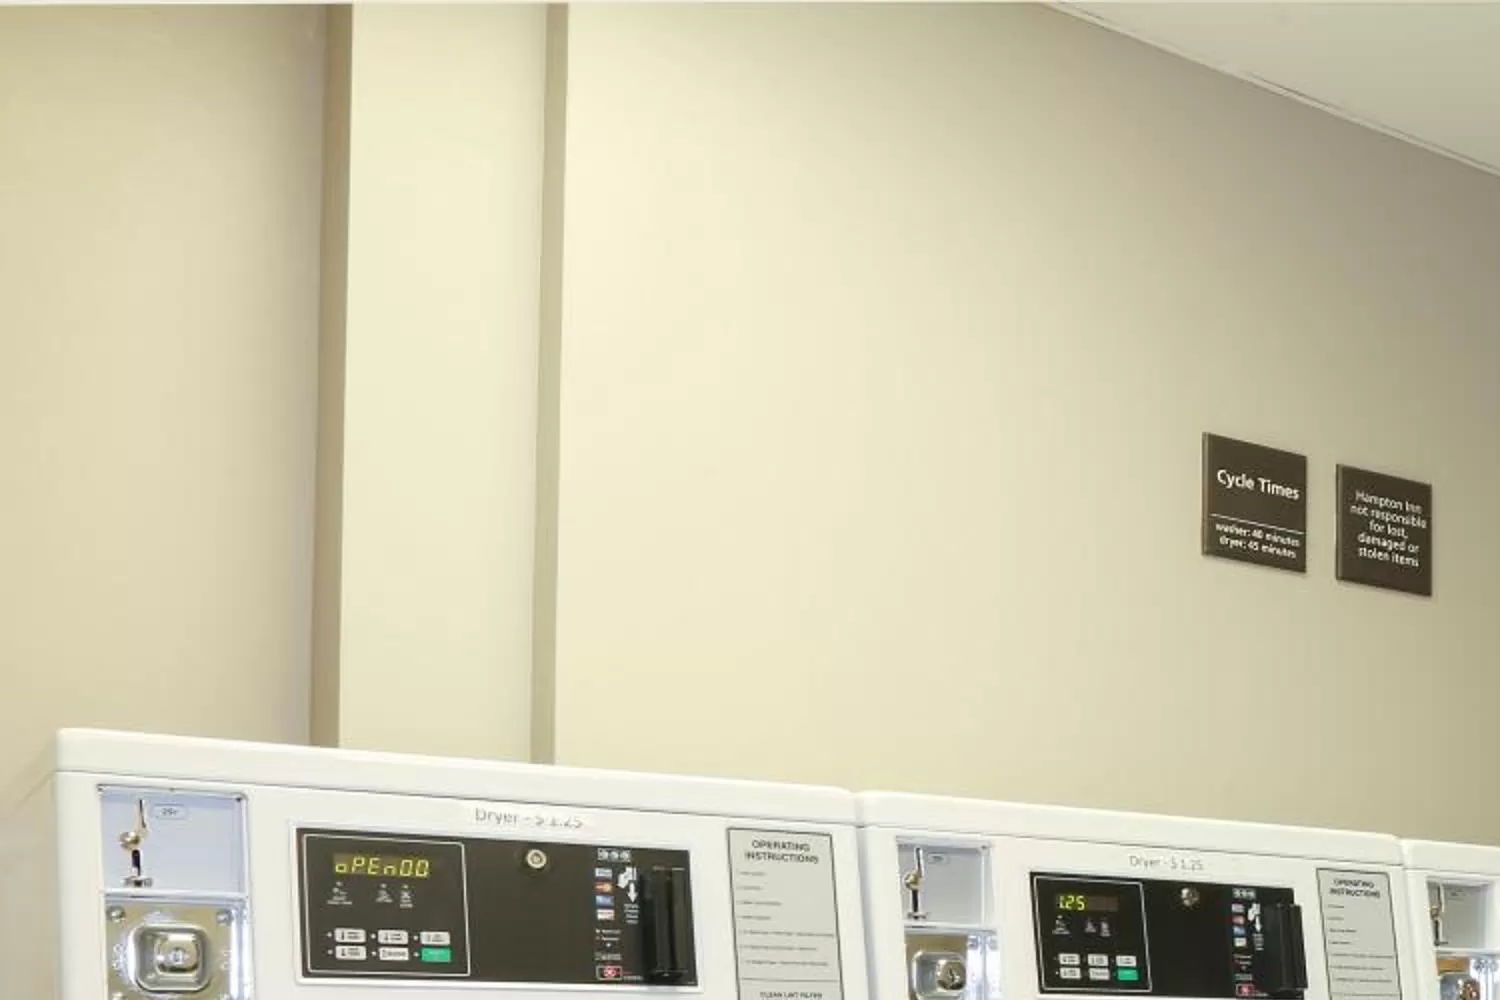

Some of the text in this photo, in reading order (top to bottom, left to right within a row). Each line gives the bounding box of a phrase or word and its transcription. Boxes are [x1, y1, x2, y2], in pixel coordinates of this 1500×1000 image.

[1217, 469, 1300, 500] Cycle Times
[1355, 490, 1403, 511] Hampton
[1350, 505, 1427, 528] not responsible
[1369, 520, 1385, 532] for
[1357, 532, 1419, 553] damaged or
[1358, 547, 1419, 567] stolen items
[475, 807, 518, 825] Dryer
[751, 839, 810, 852] OPERATING
[744, 851, 819, 864] INSTRUCTIONS
[1329, 887, 1381, 899] INSTRUCTIONS
[1333, 879, 1375, 889] OPERATING
